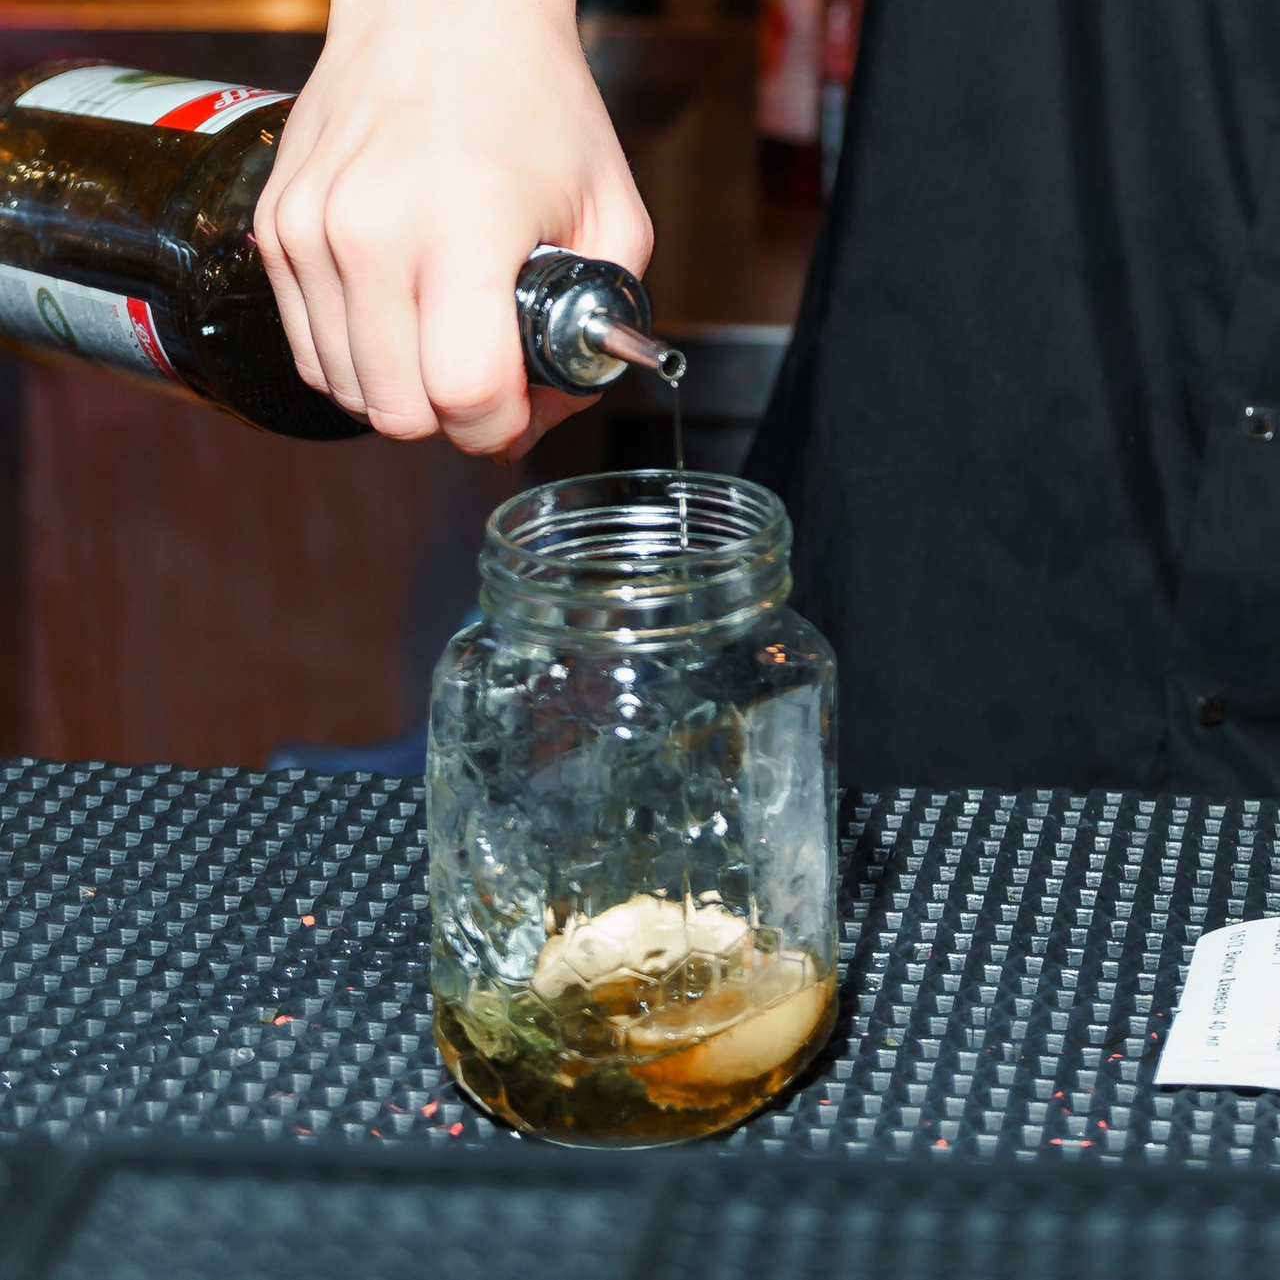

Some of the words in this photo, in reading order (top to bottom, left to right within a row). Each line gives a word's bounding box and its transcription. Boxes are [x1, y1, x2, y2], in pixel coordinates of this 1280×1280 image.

[1221, 950, 1242, 974] Виски
[1208, 1020, 1228, 1030] 40
[1206, 1035, 1219, 1047] мл
